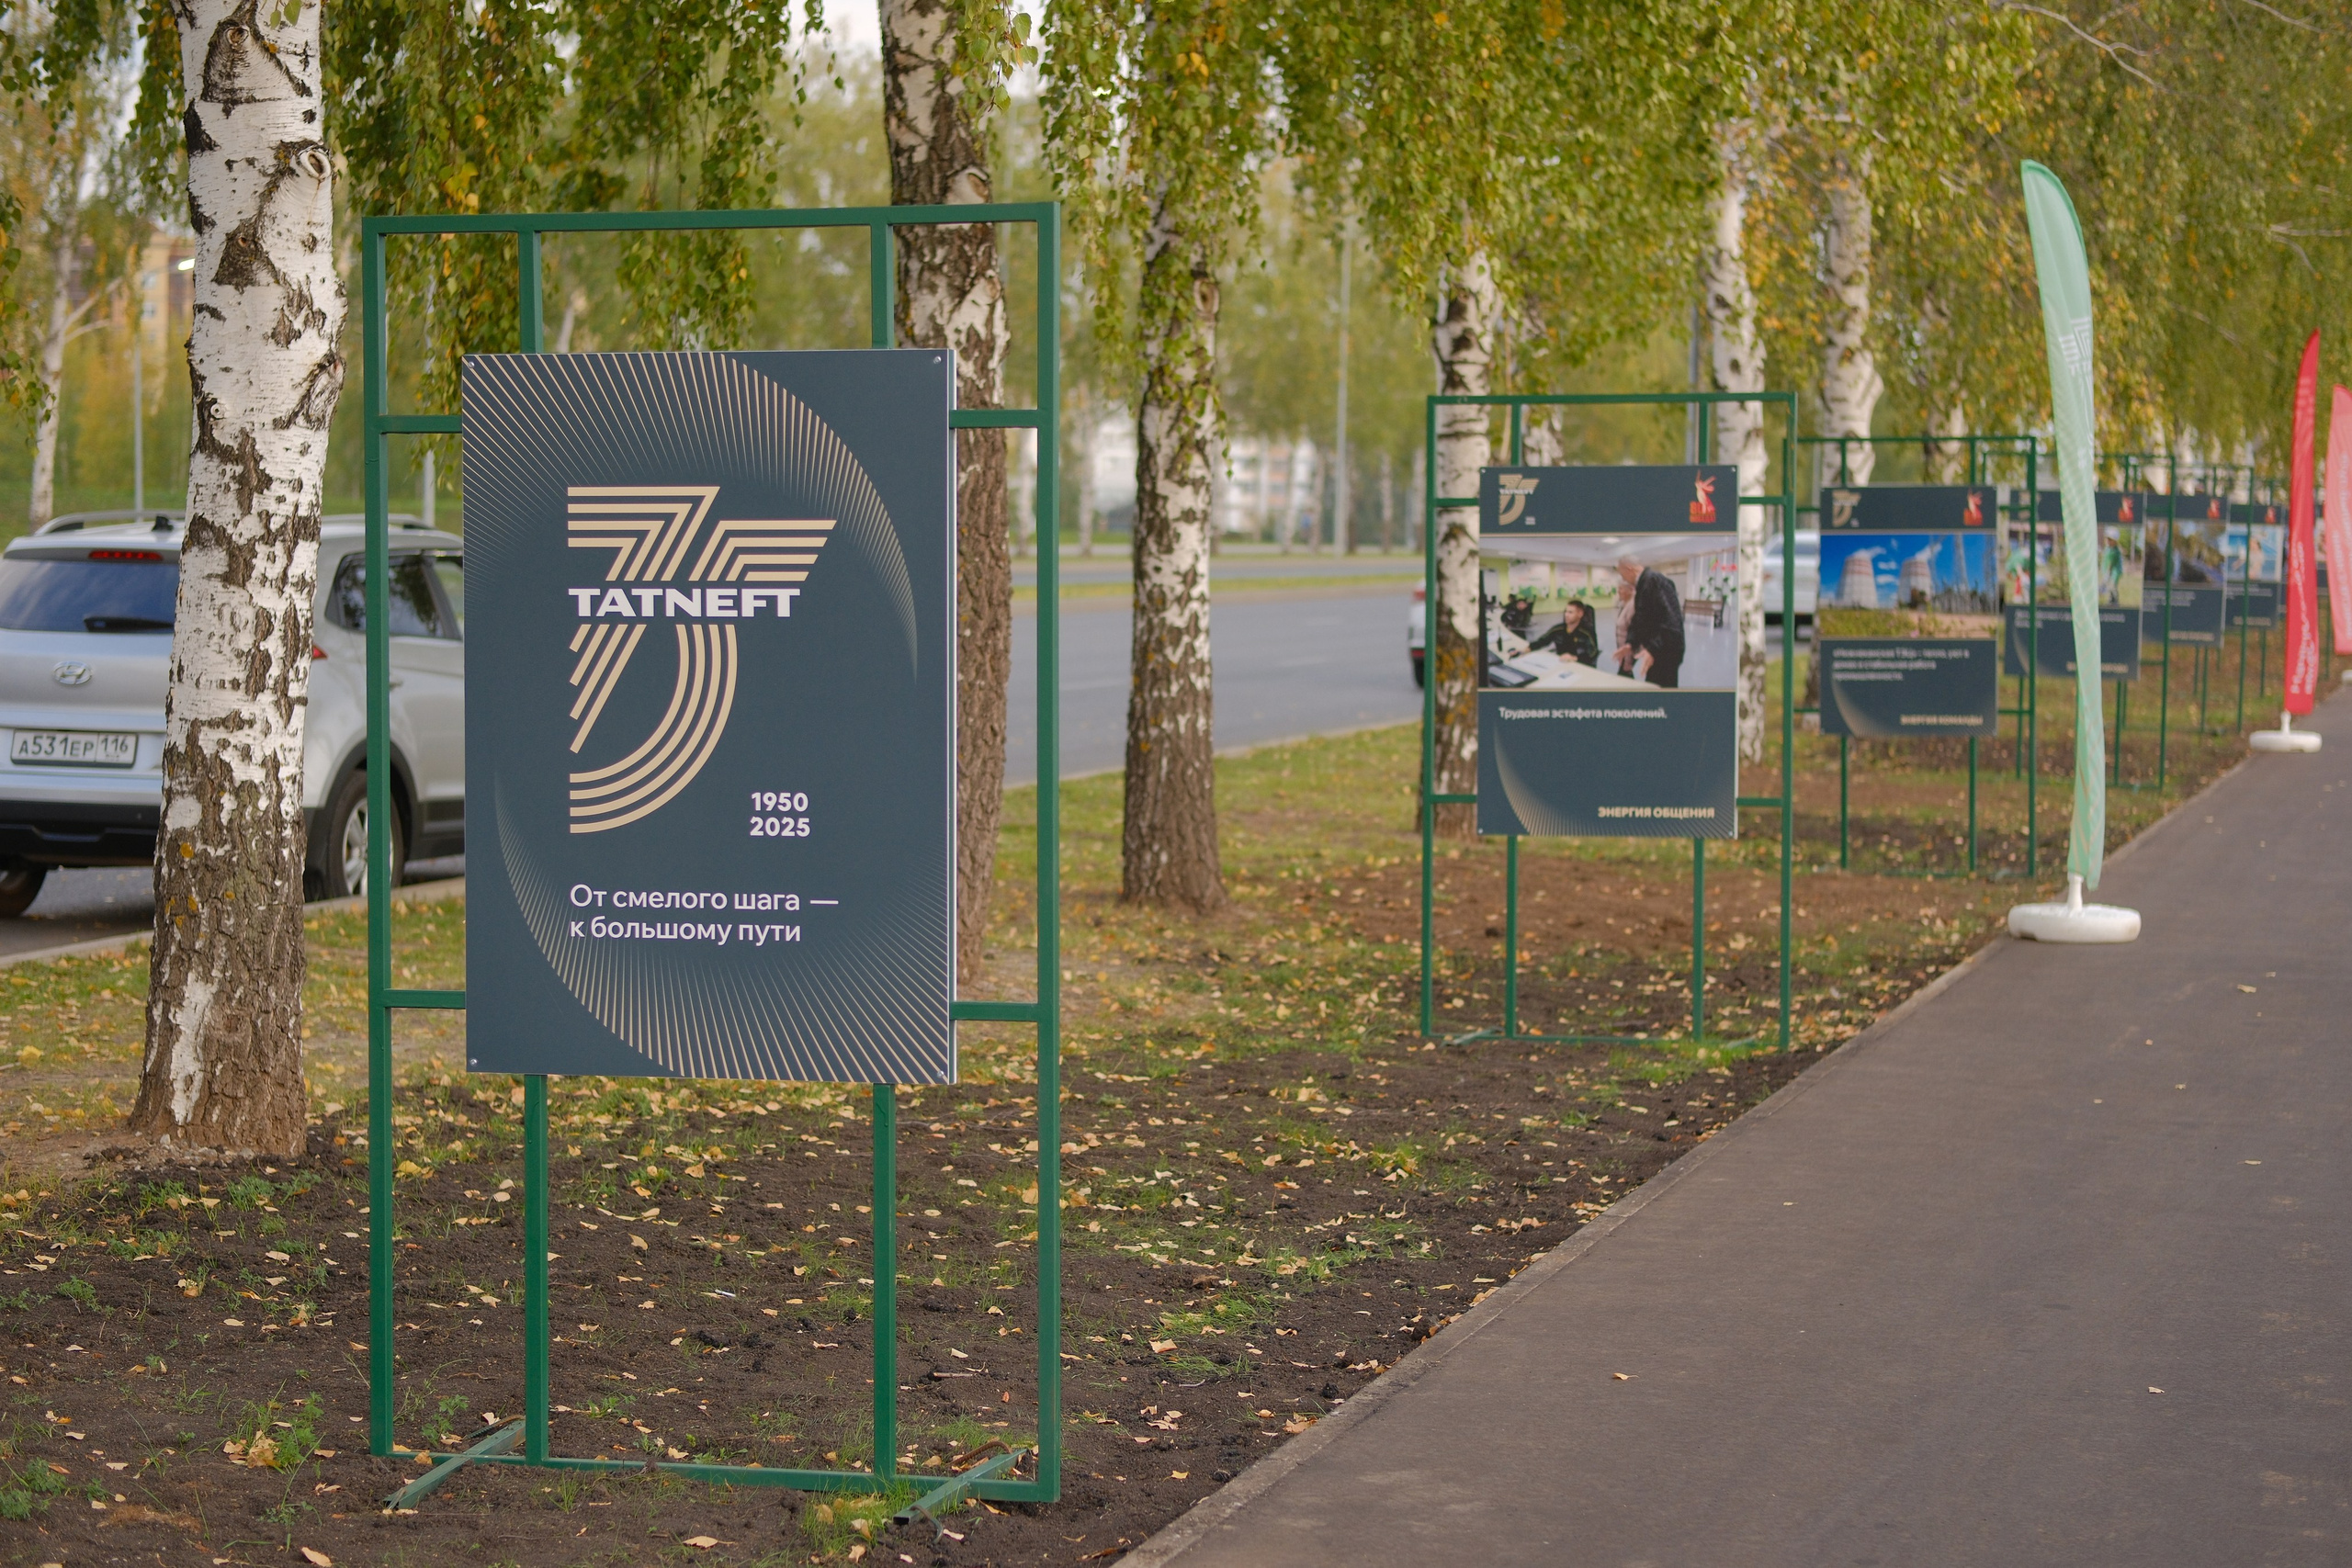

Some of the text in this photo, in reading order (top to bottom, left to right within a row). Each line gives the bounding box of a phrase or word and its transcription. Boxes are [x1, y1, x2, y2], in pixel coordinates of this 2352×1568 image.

[568, 588, 801, 617] TATNEFT
[1498, 706, 1668, 720] Трудовая эстафета поколений.
[100, 736, 129, 753] 116
[751, 792, 808, 812] 1950
[1598, 807, 1715, 819] ЭНЕРГИЯ ОБЩЕНИЯ
[750, 816, 810, 837] 2025
[570, 884, 607, 908] От
[613, 890, 728, 910] смелого
[734, 893, 800, 911] шага
[571, 915, 800, 946] к большому пути
